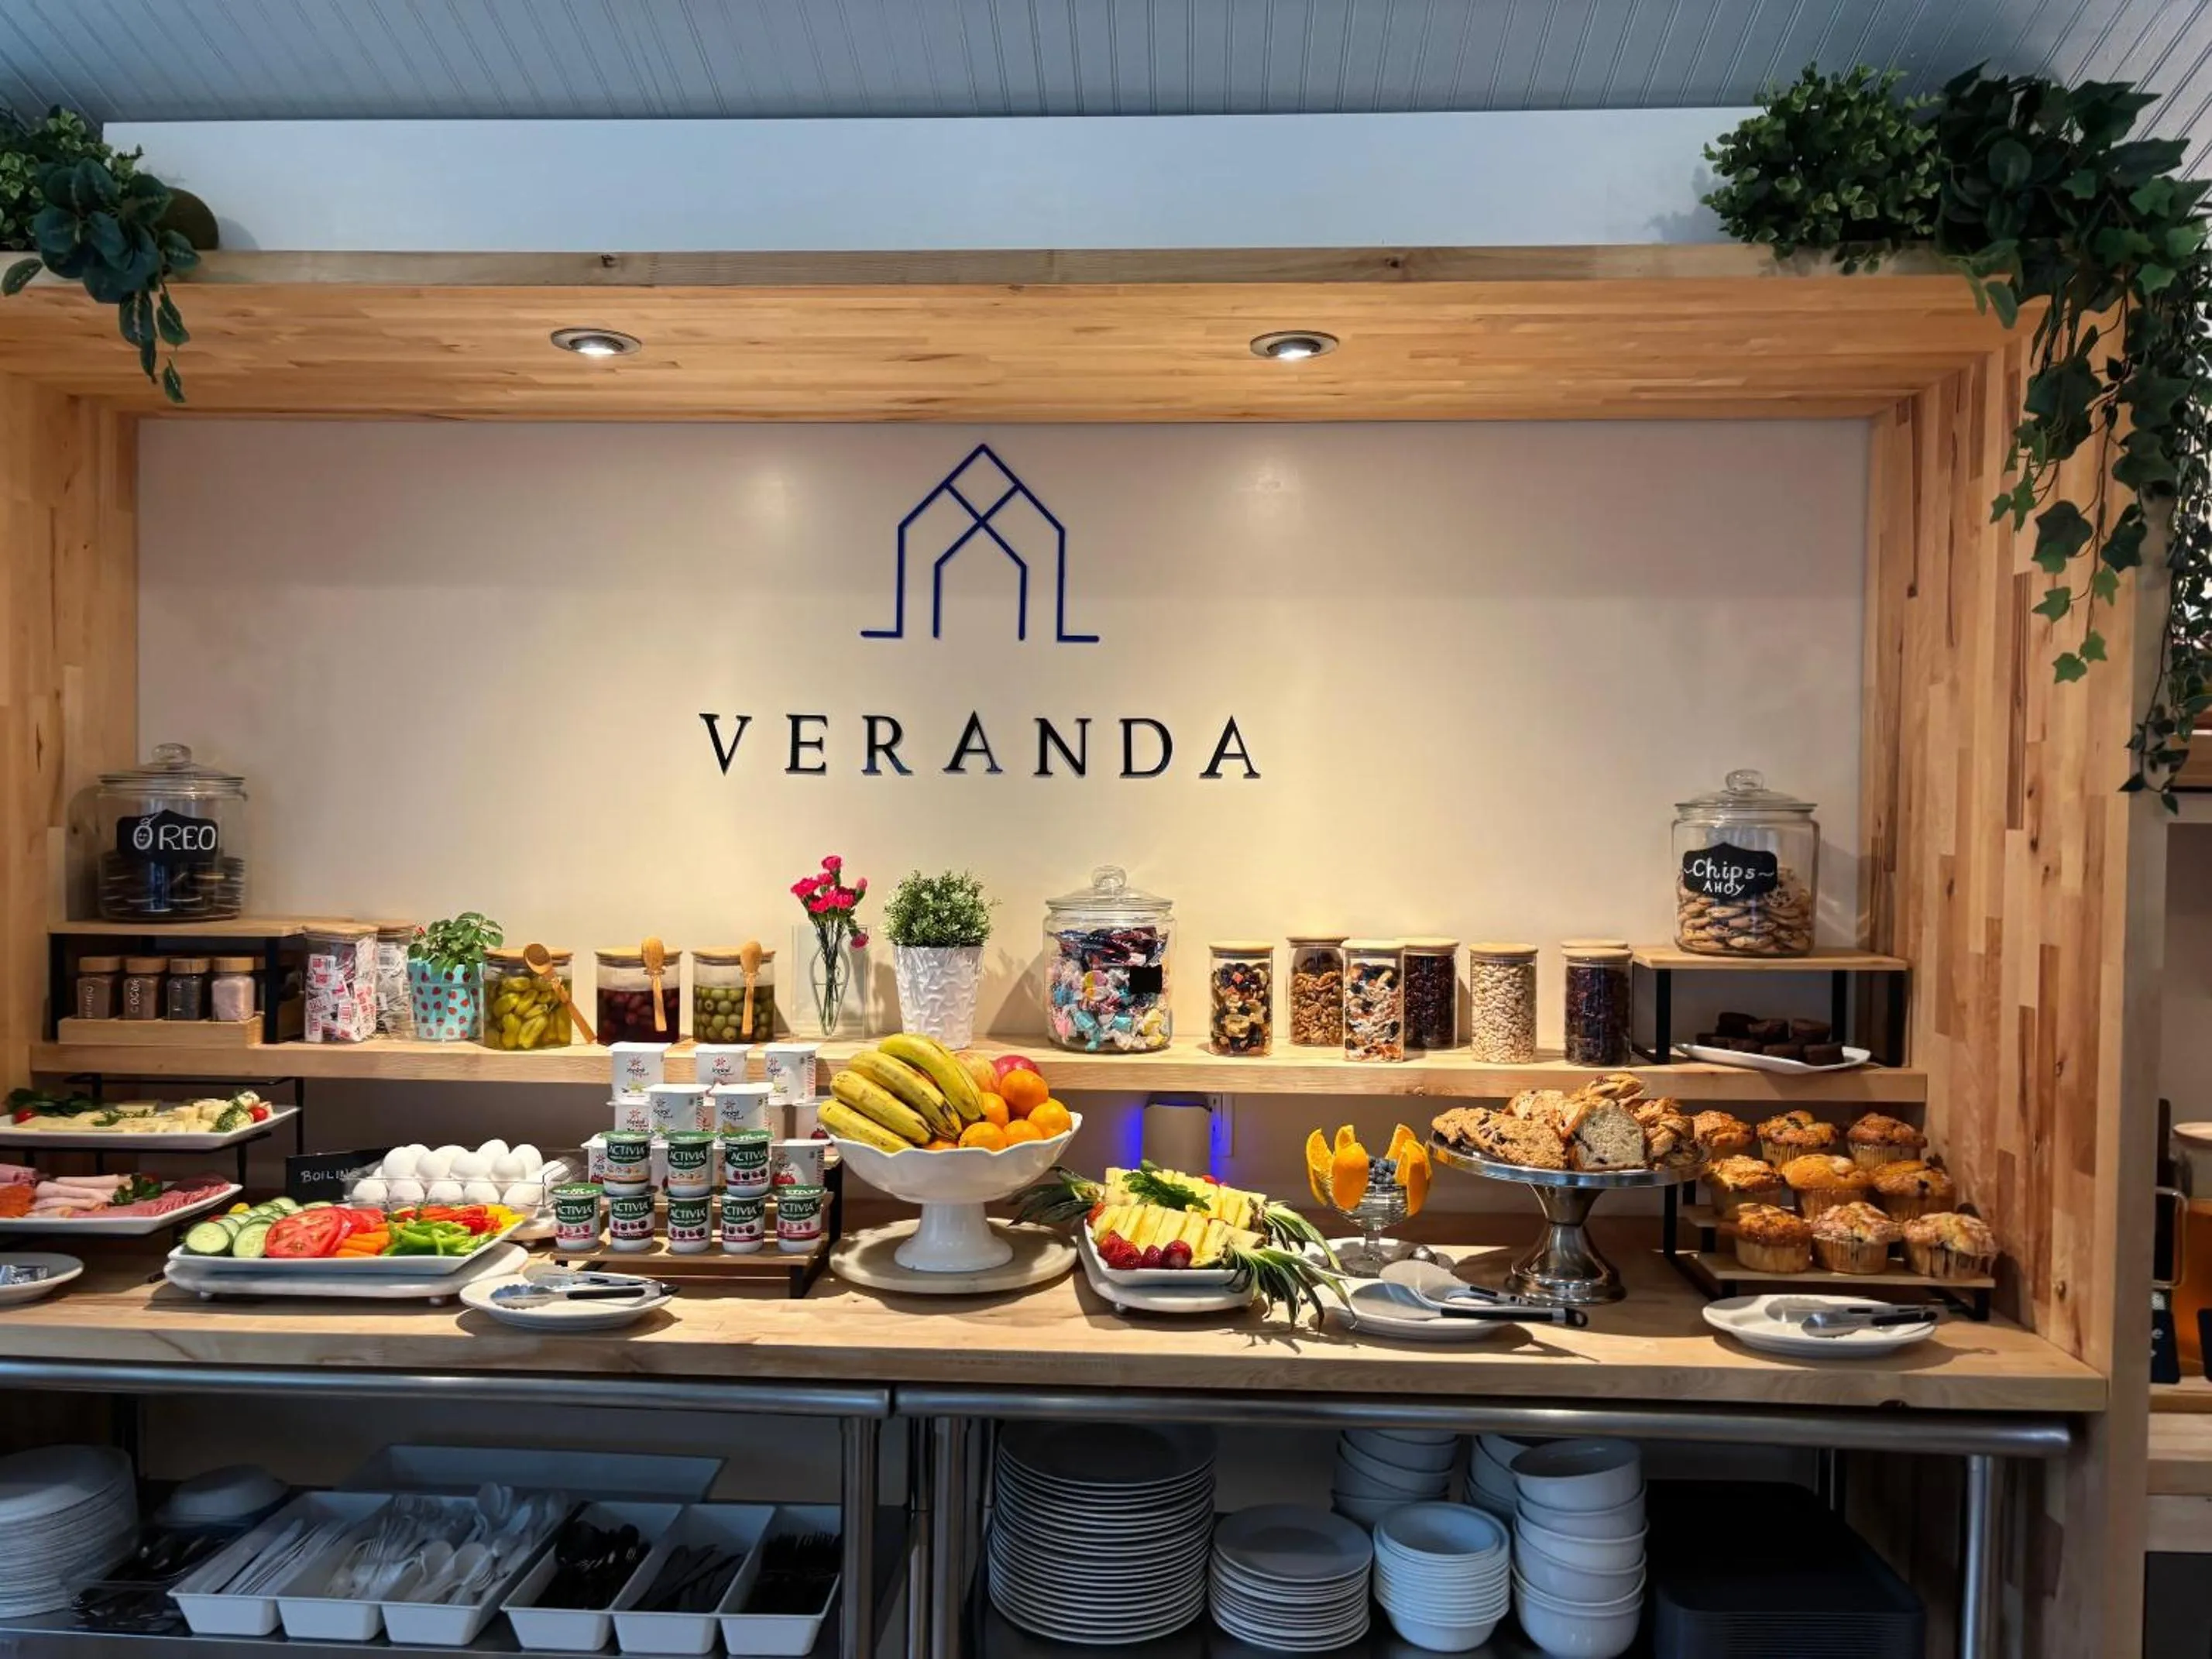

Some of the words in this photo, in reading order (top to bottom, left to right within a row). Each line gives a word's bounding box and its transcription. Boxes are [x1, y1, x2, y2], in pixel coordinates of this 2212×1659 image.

[699, 709, 1261, 779] VERANDA
[132, 823, 217, 850] OREO
[1692, 857, 1757, 886] Chips
[1702, 880, 1746, 897] AHOY
